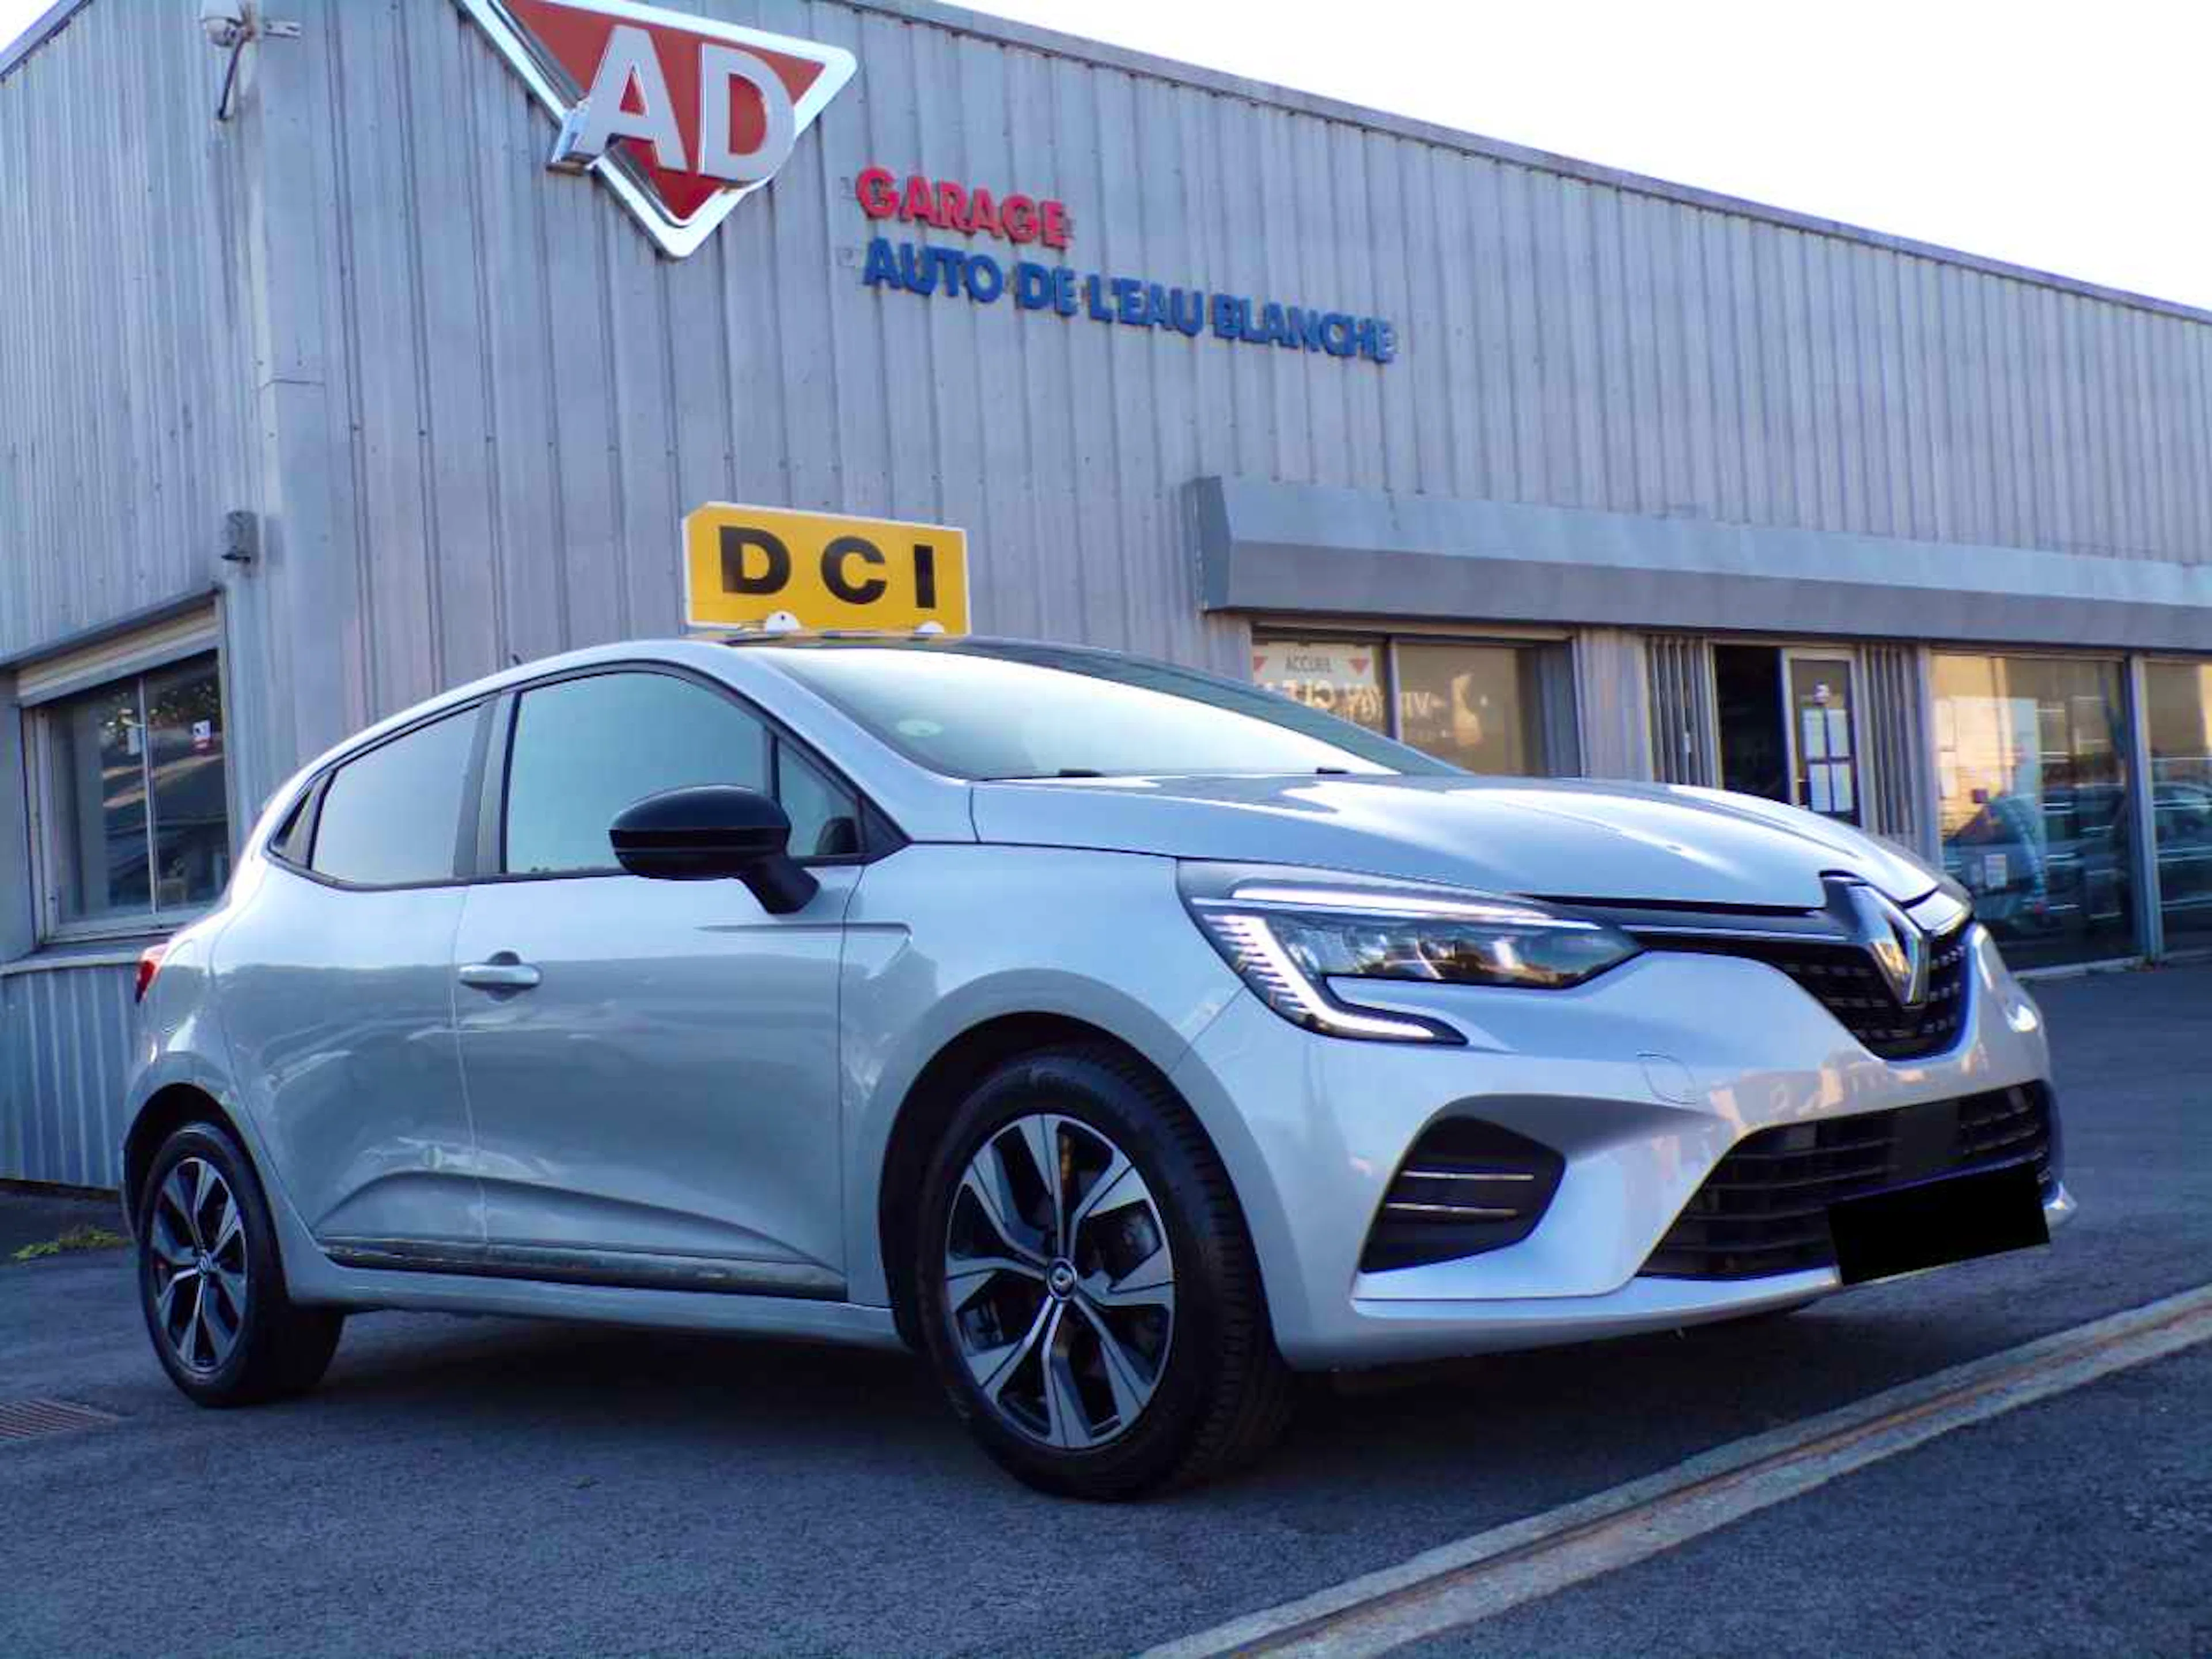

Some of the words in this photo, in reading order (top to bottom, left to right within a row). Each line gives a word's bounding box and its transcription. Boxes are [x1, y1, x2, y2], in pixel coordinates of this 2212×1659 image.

[554, 25, 797, 181] AD
[857, 166, 1074, 250] GARAGE
[862, 237, 1003, 303] AUTO
[1015, 260, 1078, 316] DE
[1088, 273, 1203, 336] L'EAU
[1212, 292, 1396, 363] BLANCHE
